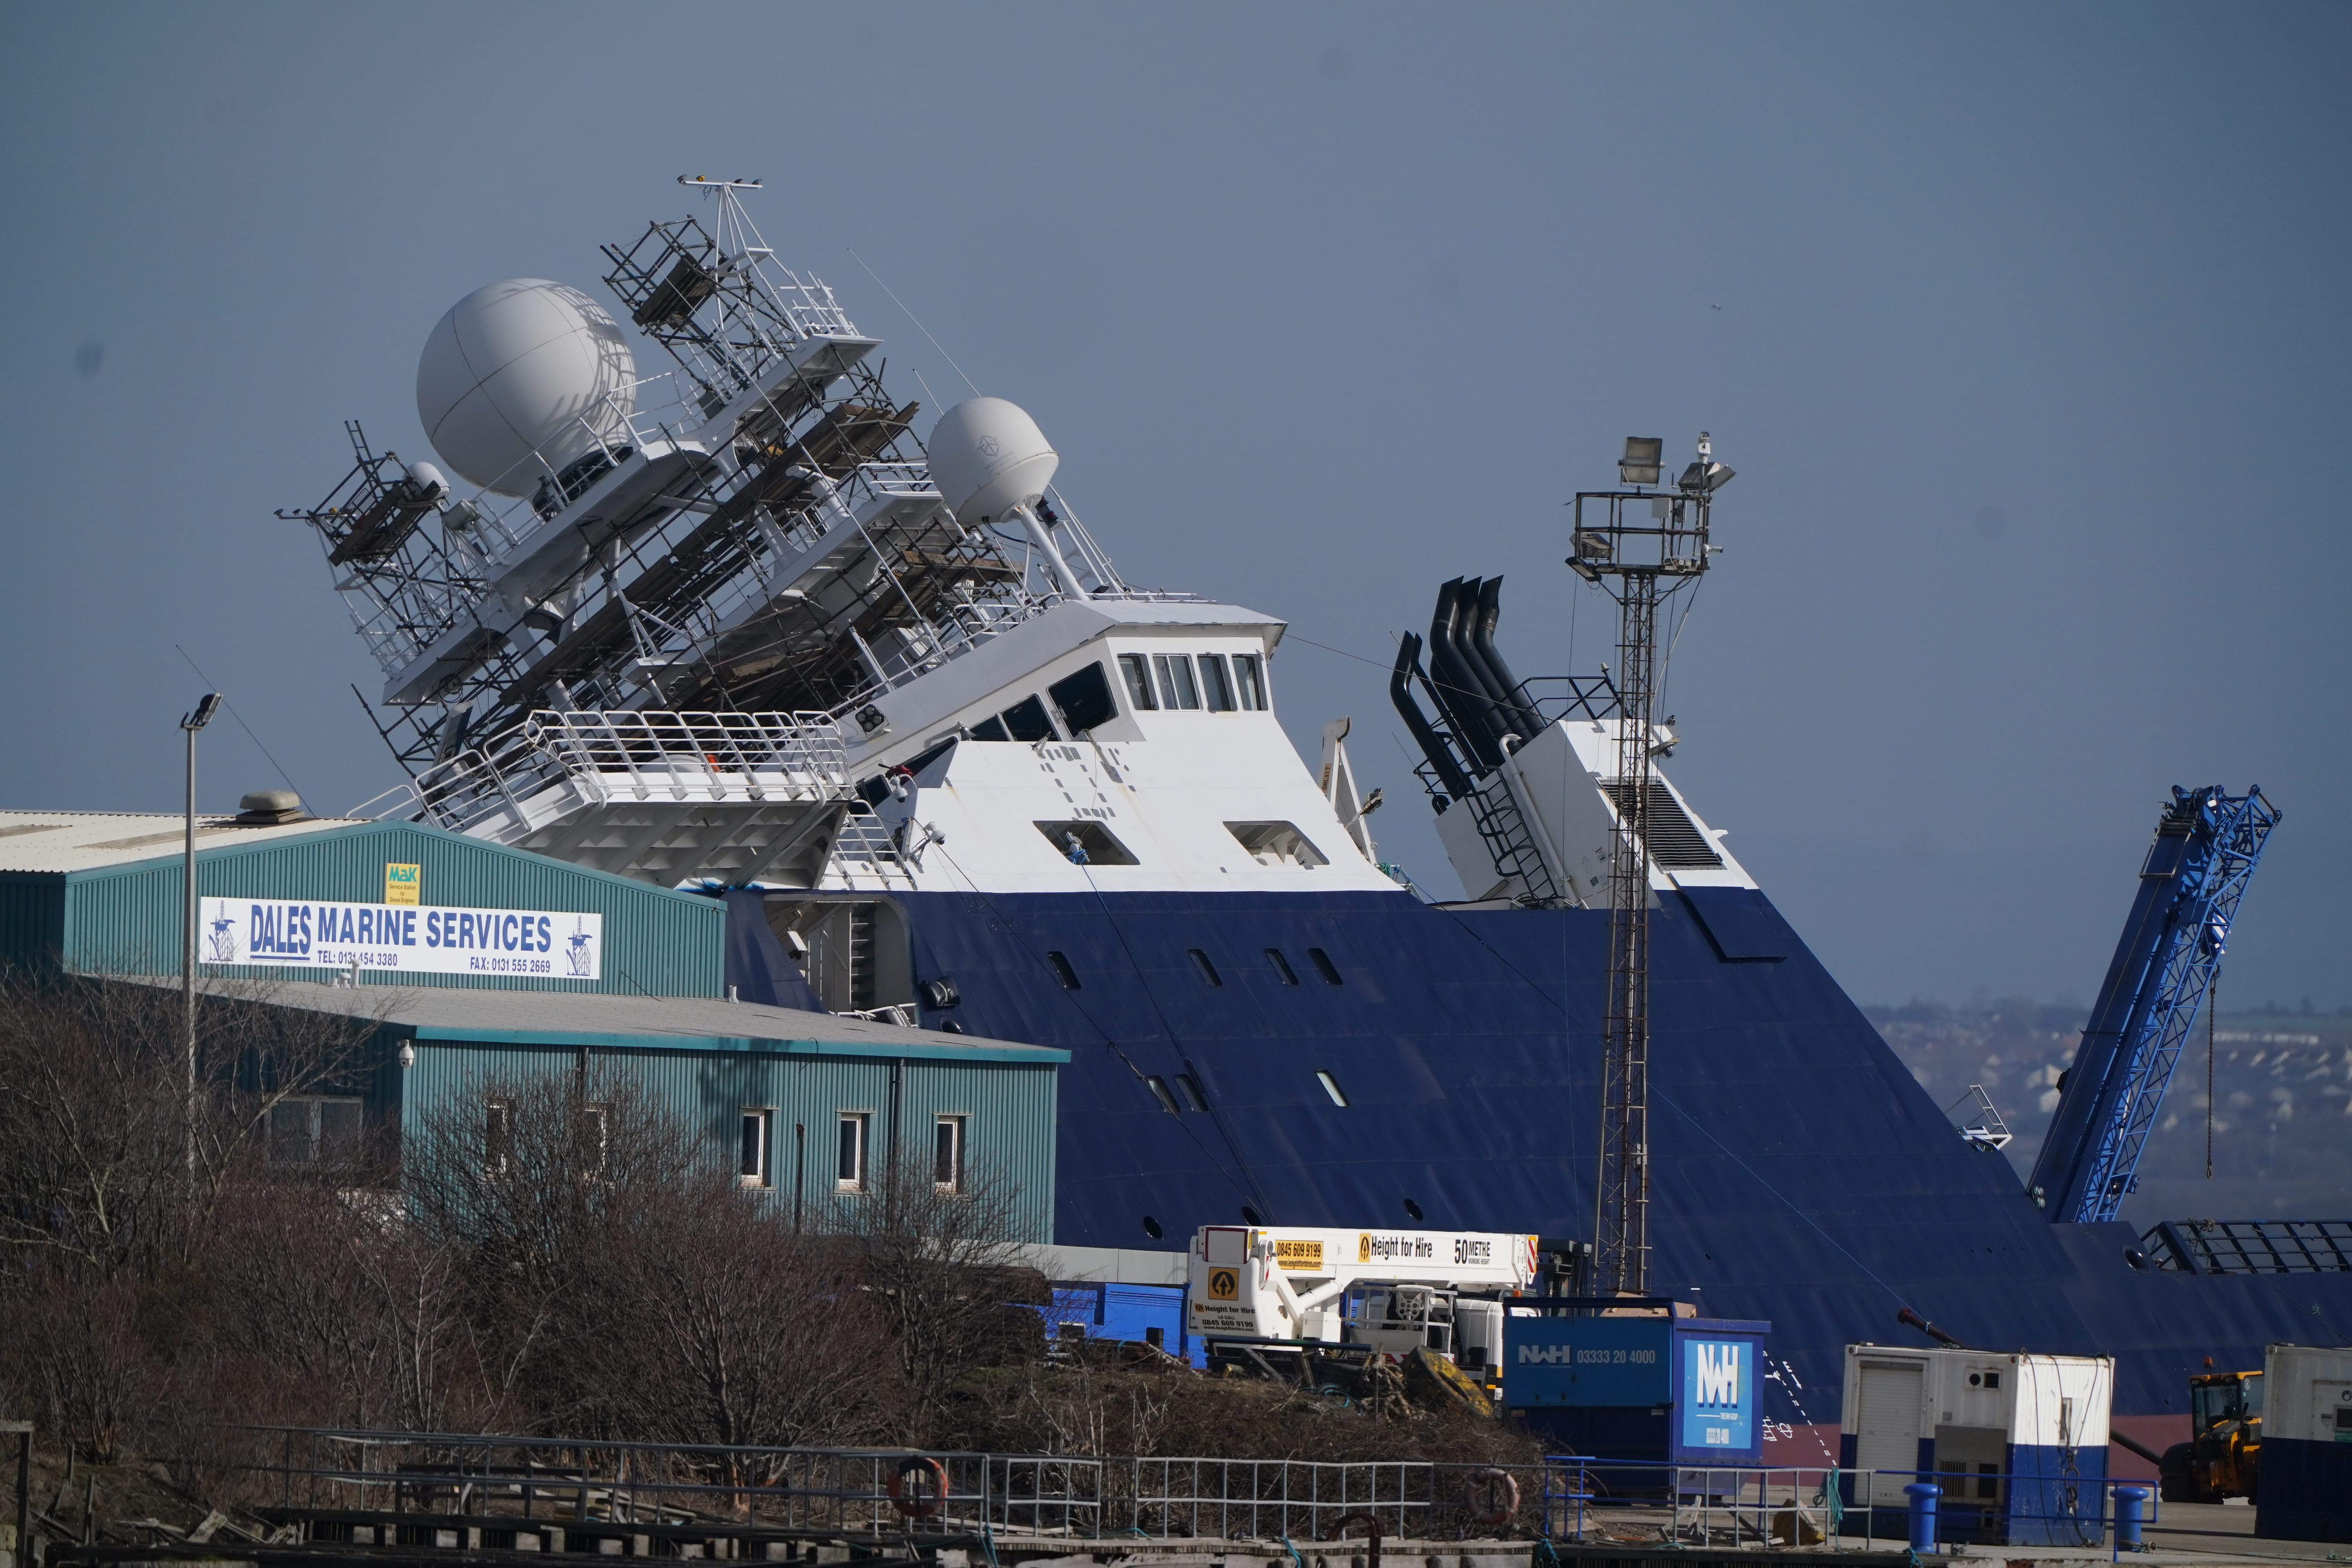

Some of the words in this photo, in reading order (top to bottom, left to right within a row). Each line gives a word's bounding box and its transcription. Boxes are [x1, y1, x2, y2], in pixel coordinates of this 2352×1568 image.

[388, 866, 418, 882] MaK
[250, 904, 311, 955] DALES
[318, 906, 416, 946] MARINE
[426, 911, 551, 953] SERVICES
[318, 950, 335, 964] TEL:
[377, 953, 397, 966] 3380
[470, 957, 489, 970] FAX:
[492, 958, 509, 971] 0131
[512, 959, 527, 972] 555
[530, 960, 550, 973] 2669
[1277, 1242, 1291, 1256] 0845
[1293, 1243, 1304, 1257] 609
[1306, 1243, 1321, 1257] 9199
[1371, 1236, 1398, 1260] Height
[1401, 1237, 1412, 1257] for
[1415, 1237, 1432, 1258] Hire
[1455, 1239, 1468, 1264] 50
[1469, 1241, 1490, 1257] METRE
[1519, 1345, 1570, 1364] NWH
[1577, 1350, 1610, 1363] 03333
[1613, 1350, 1626, 1364] 20
[1629, 1350, 1655, 1364] 4000
[1697, 1343, 1739, 1406] NWH
